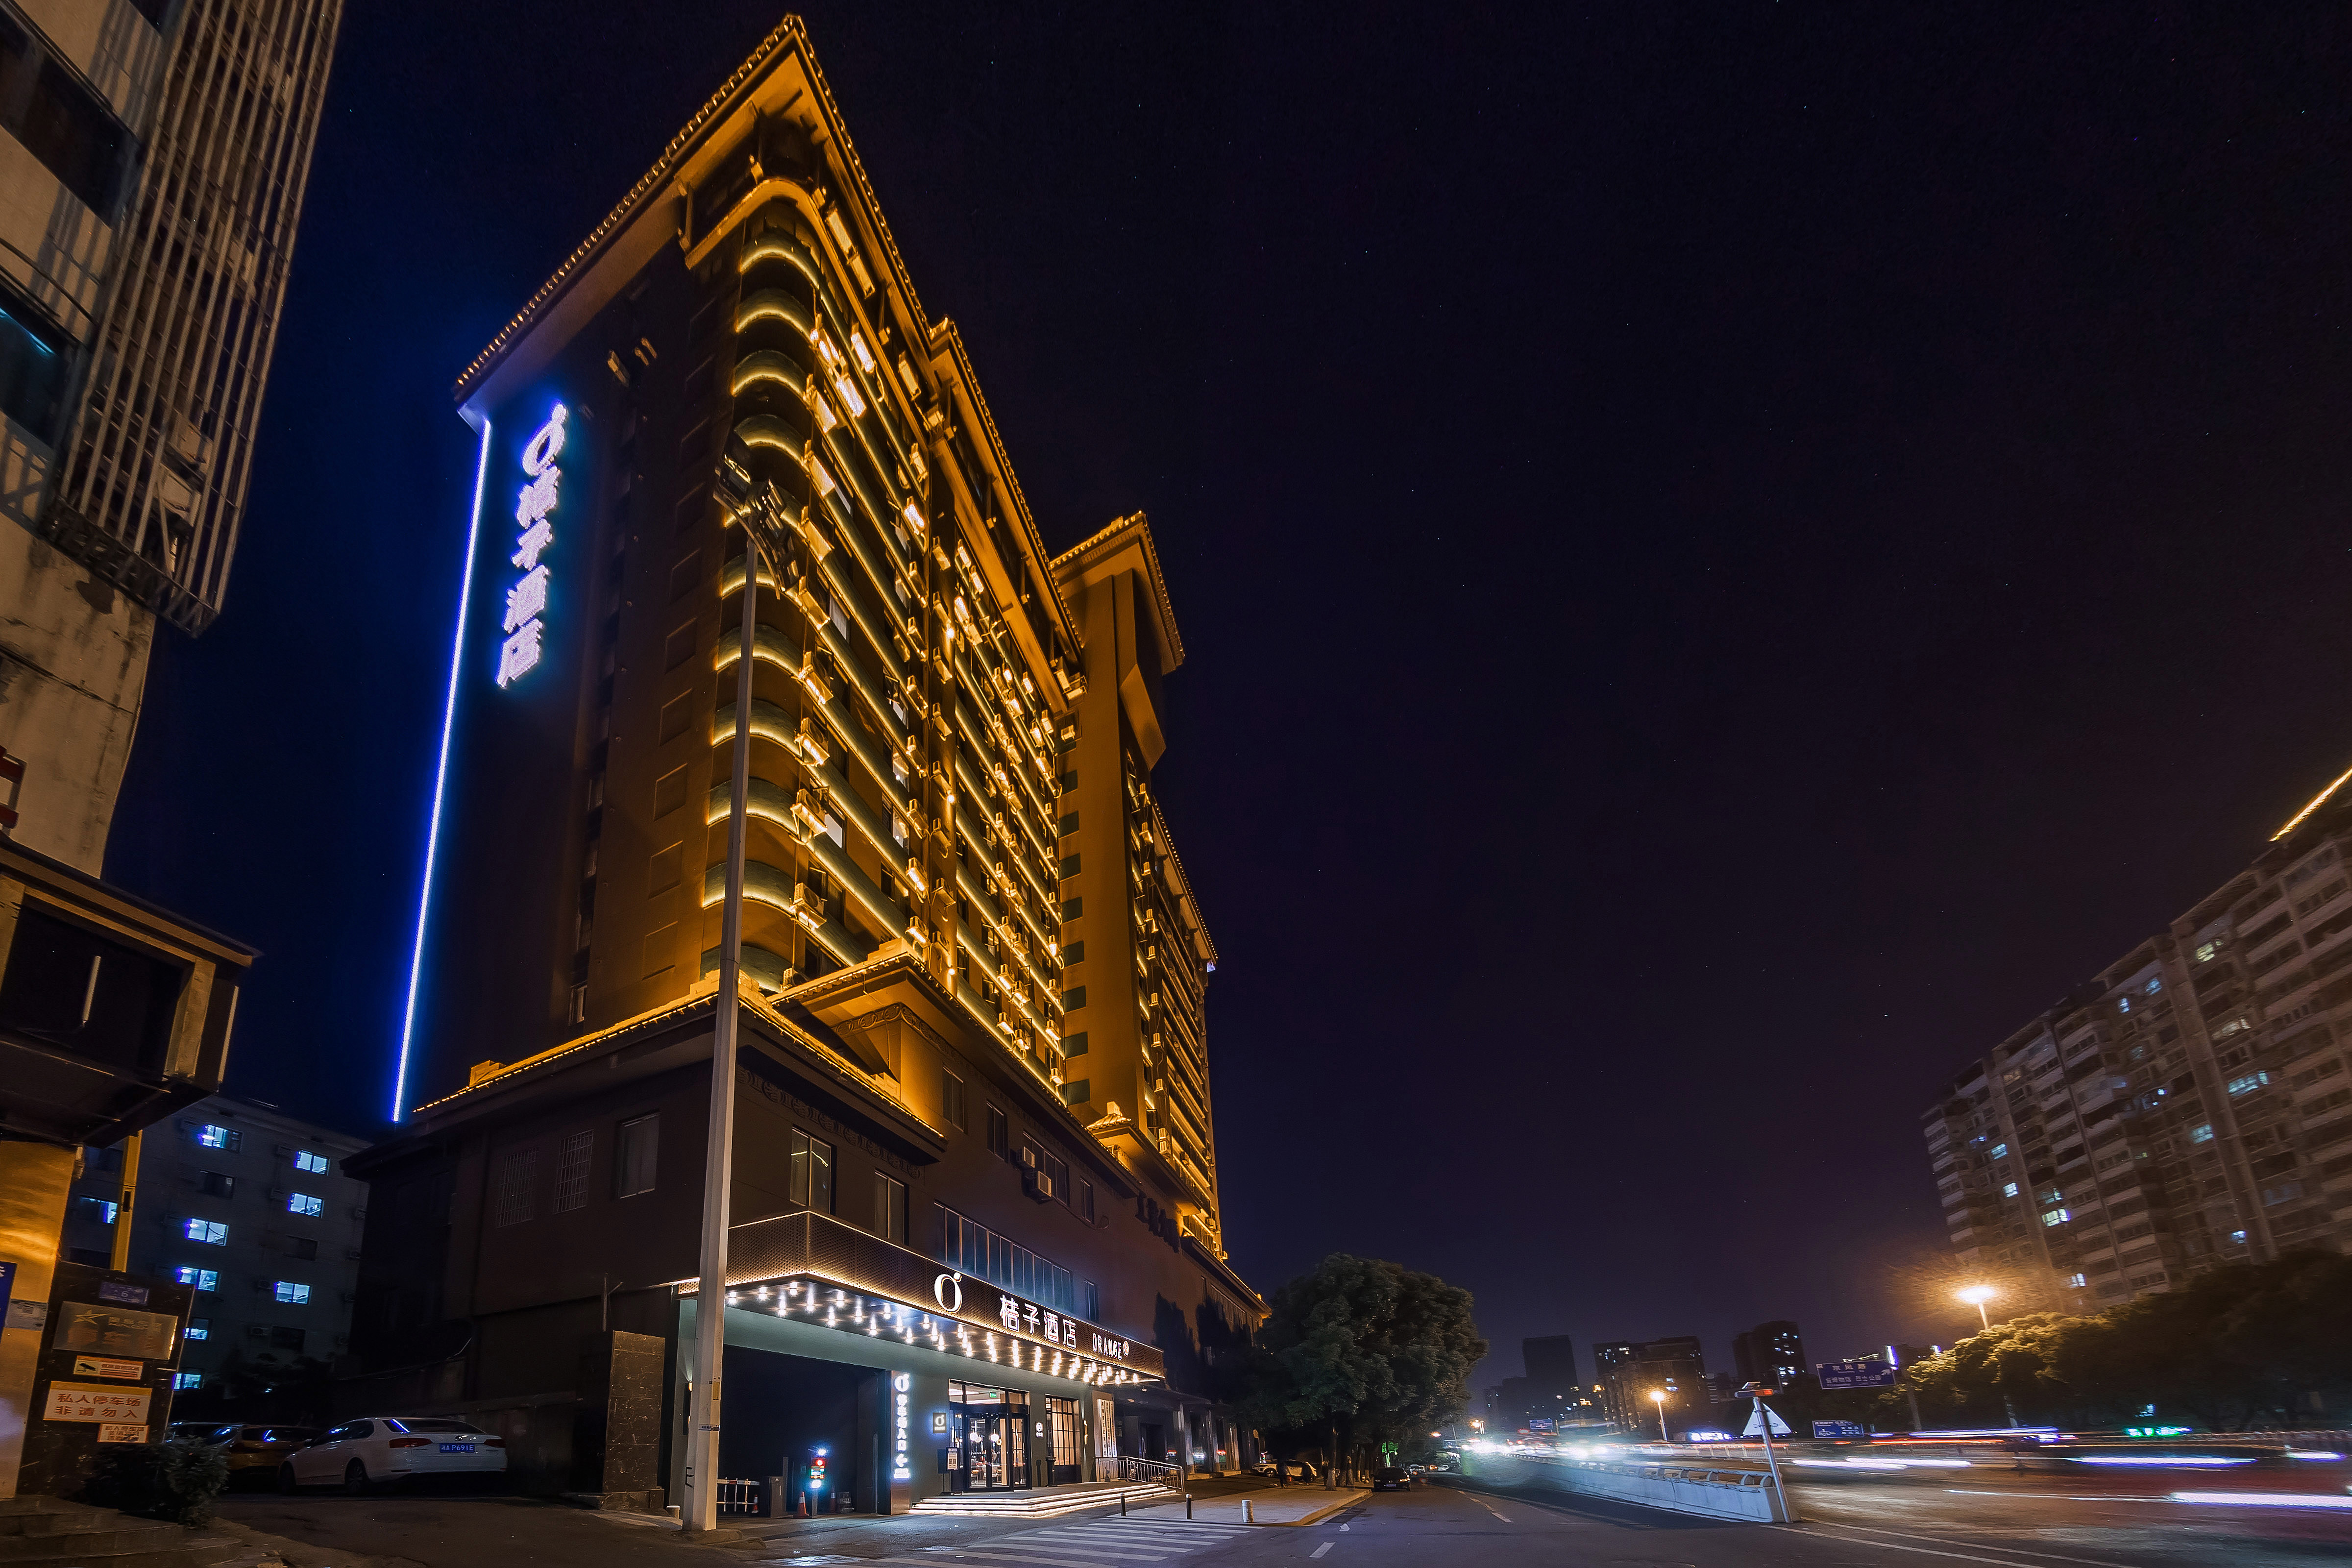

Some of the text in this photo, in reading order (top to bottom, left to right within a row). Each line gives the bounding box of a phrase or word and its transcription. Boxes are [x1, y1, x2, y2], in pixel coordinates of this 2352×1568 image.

[999, 1294, 1077, 1349] 桔子酒店
[1092, 1333, 1122, 1360] ORANGE
[57, 1393, 141, 1407] 私人停车场
[55, 1405, 138, 1418] 非请勿入
